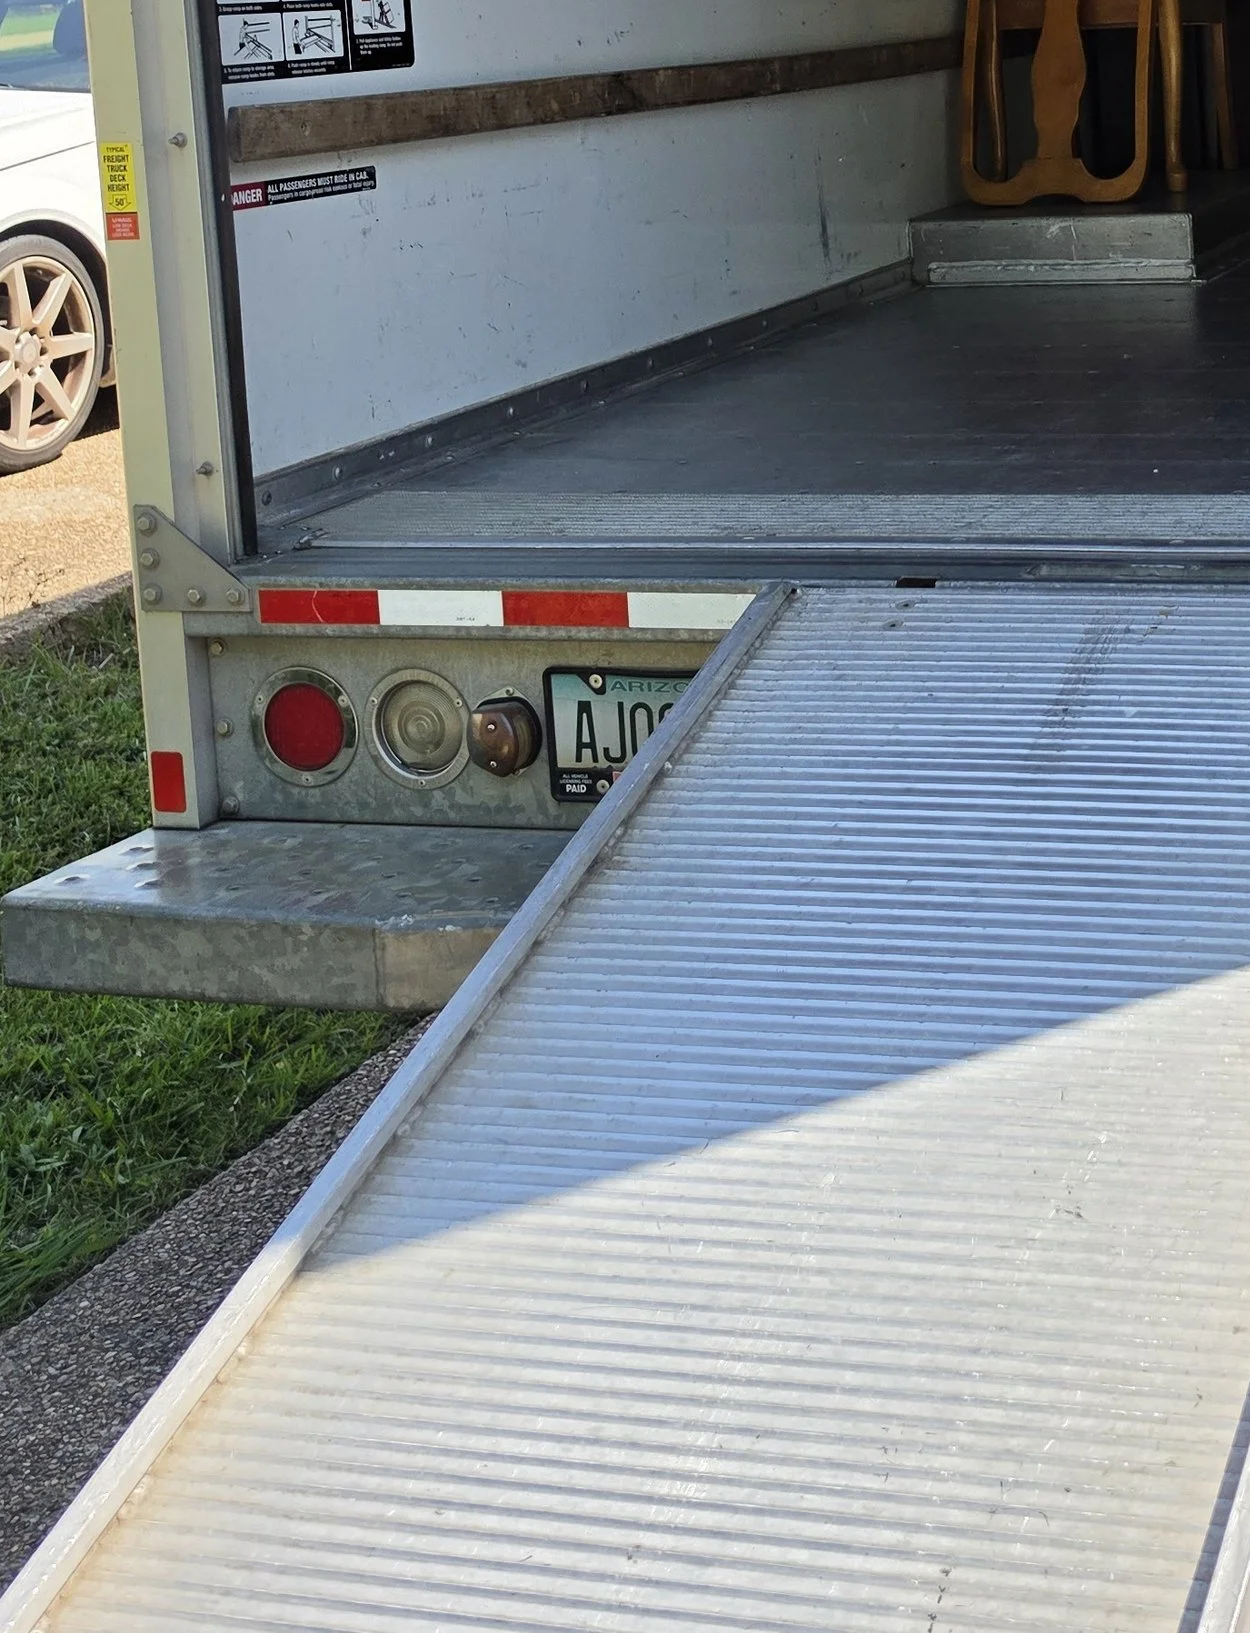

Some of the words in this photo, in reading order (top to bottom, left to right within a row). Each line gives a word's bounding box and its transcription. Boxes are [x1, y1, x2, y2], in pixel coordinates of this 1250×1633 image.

[103, 154, 129, 163] FREIGHT
[107, 164, 128, 172] TRUCK
[109, 174, 126, 182] DECK
[107, 184, 129, 192] HEIGHT
[267, 183, 279, 194] ALL
[279, 178, 317, 192] PASSENGERS
[317, 176, 333, 186] MUST
[231, 188, 262, 206] ANGER
[267, 192, 294, 202] Passengers
[575, 700, 674, 764] AJ0
[566, 783, 587, 793] PAID
